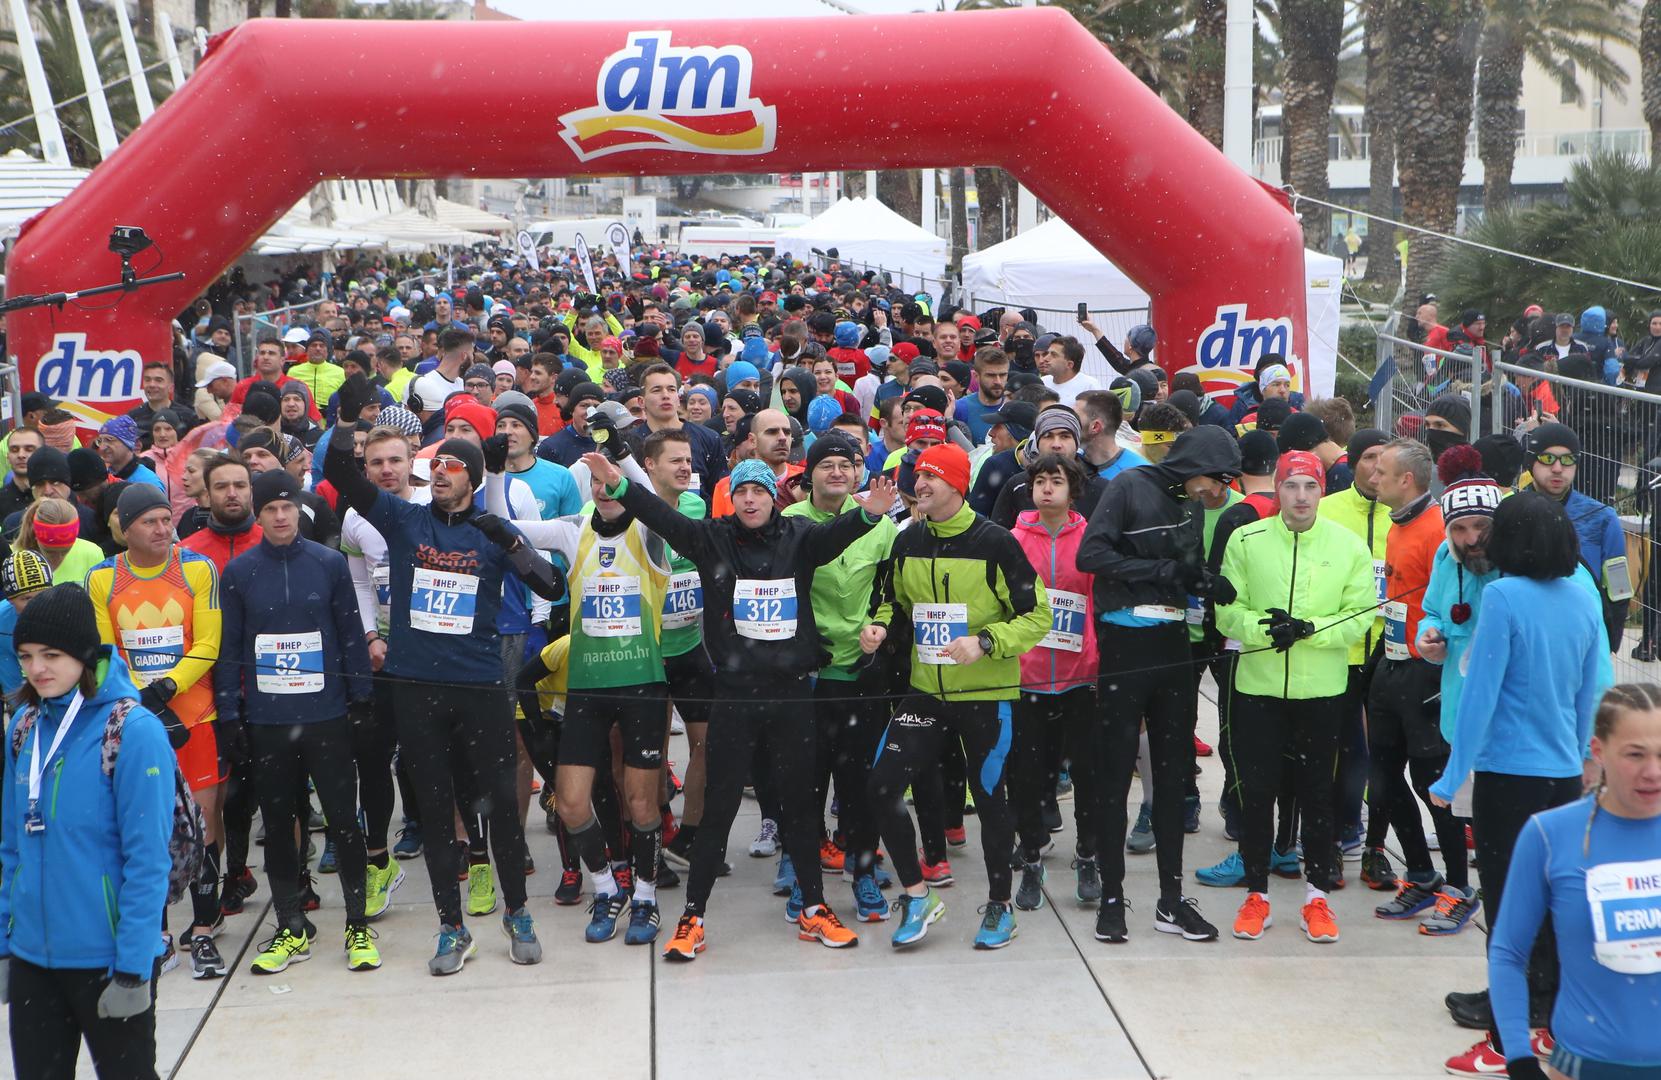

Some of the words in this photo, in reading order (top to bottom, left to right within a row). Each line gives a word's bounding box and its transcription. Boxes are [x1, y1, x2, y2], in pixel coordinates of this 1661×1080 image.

[604, 38, 740, 112] dm
[1200, 312, 1288, 369] dm
[38, 341, 135, 397] dm
[440, 579, 458, 589] HEP
[605, 584, 621, 593] HEP
[680, 579, 692, 588] HEP
[763, 587, 779, 596] HEP
[424, 590, 459, 615] 147
[592, 596, 625, 618] 163
[670, 590, 696, 612] 146
[747, 600, 782, 621] 312
[1060, 598, 1074, 607] HEP
[933, 611, 947, 619] HEP
[146, 635, 163, 645] HEP
[921, 623, 951, 646] 218
[285, 641, 302, 650] HEP
[134, 652, 176, 667] GIARDINO
[275, 653, 301, 676] 52
[1613, 907, 1661, 932] PERU
